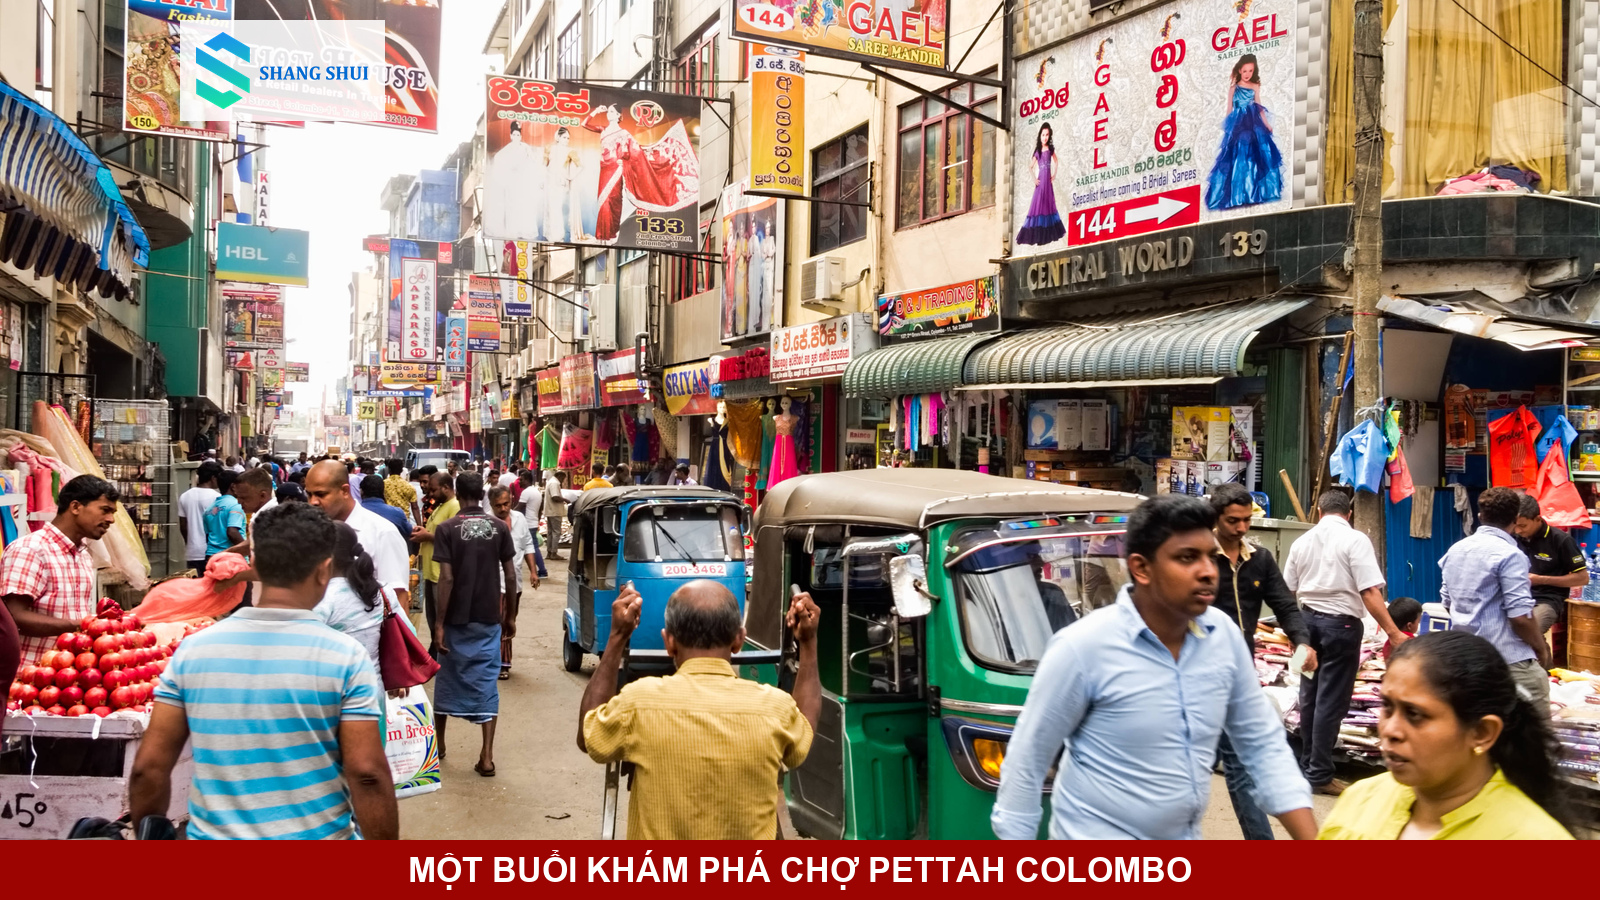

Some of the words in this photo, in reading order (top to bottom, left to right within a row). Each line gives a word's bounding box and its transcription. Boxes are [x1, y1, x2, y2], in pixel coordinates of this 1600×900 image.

[746, 8, 786, 28] 144
[849, 2, 943, 49] GAEL
[1211, 13, 1288, 52] GAEL
[848, 37, 889, 58] SAREE
[891, 45, 942, 66] MANDIR
[1217, 48, 1243, 62] SAREE
[1245, 39, 1280, 56] MANDIR
[134, 117, 152, 128] 150
[1093, 64, 1111, 169] GAEL
[1076, 173, 1100, 187] SAREE
[1100, 166, 1130, 181] MANDIR
[1100, 187, 1117, 200] Home
[1148, 172, 1169, 189] Bridal
[1172, 169, 1197, 184] Sarees
[636, 217, 685, 236] 133
[1076, 206, 1117, 239] 144
[225, 245, 269, 261] HBL
[1027, 251, 1107, 291] CENTRAL
[1118, 236, 1194, 276] WORLD
[1219, 228, 1268, 259] 139
[896, 300, 904, 315] D
[906, 297, 914, 314] &
[915, 295, 922, 312] J
[924, 284, 975, 311] TRADING
[410, 285, 420, 348] APSARAS
[411, 349, 426, 357] 113
[362, 406, 374, 414] 79
[665, 564, 724, 575] 200-3462
[405, 724, 434, 740] Bros
